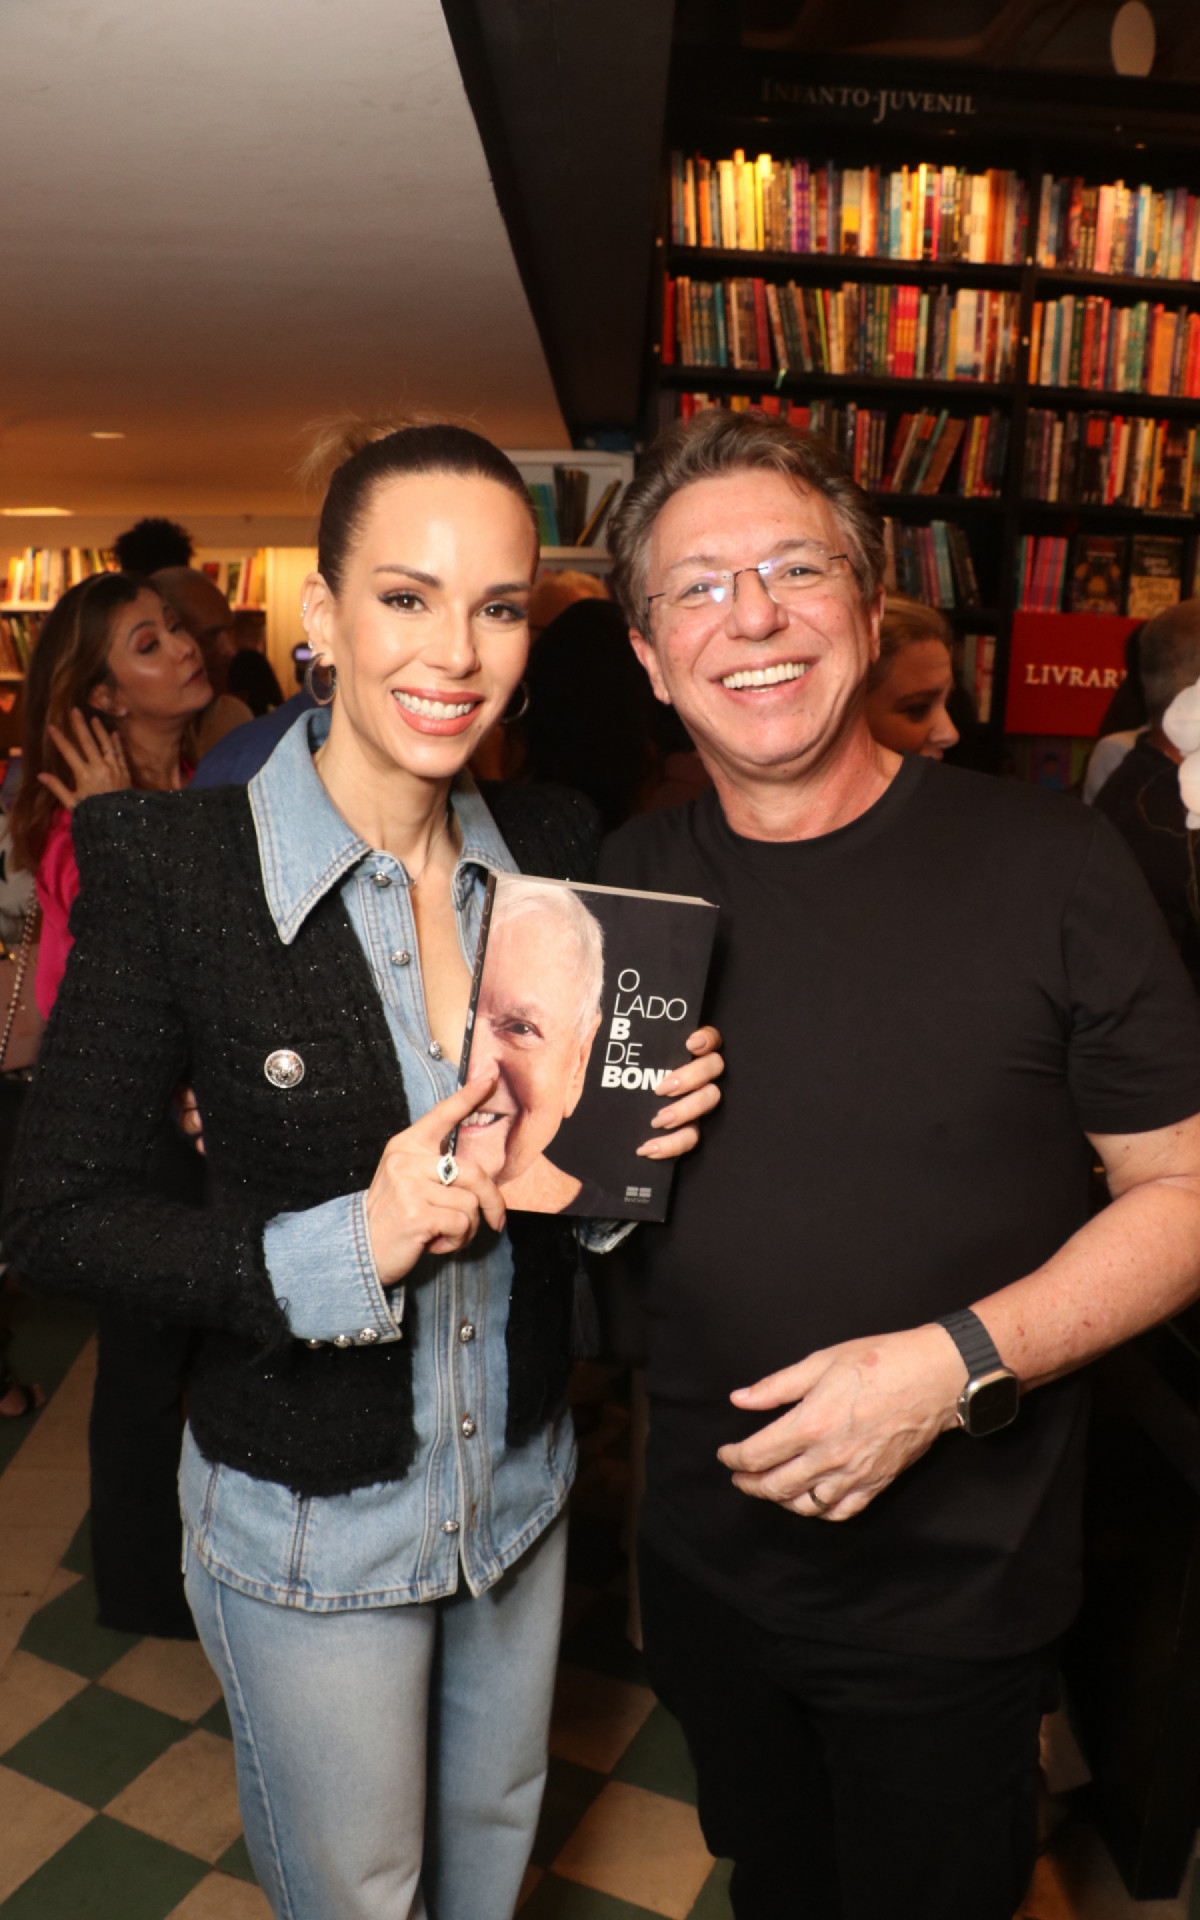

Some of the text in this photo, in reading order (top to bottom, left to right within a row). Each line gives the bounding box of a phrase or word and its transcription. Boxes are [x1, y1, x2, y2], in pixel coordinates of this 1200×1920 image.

[617, 968, 640, 992] O
[613, 993, 687, 1020] LADO
[609, 1017, 630, 1040] B
[605, 1041, 643, 1066] DE
